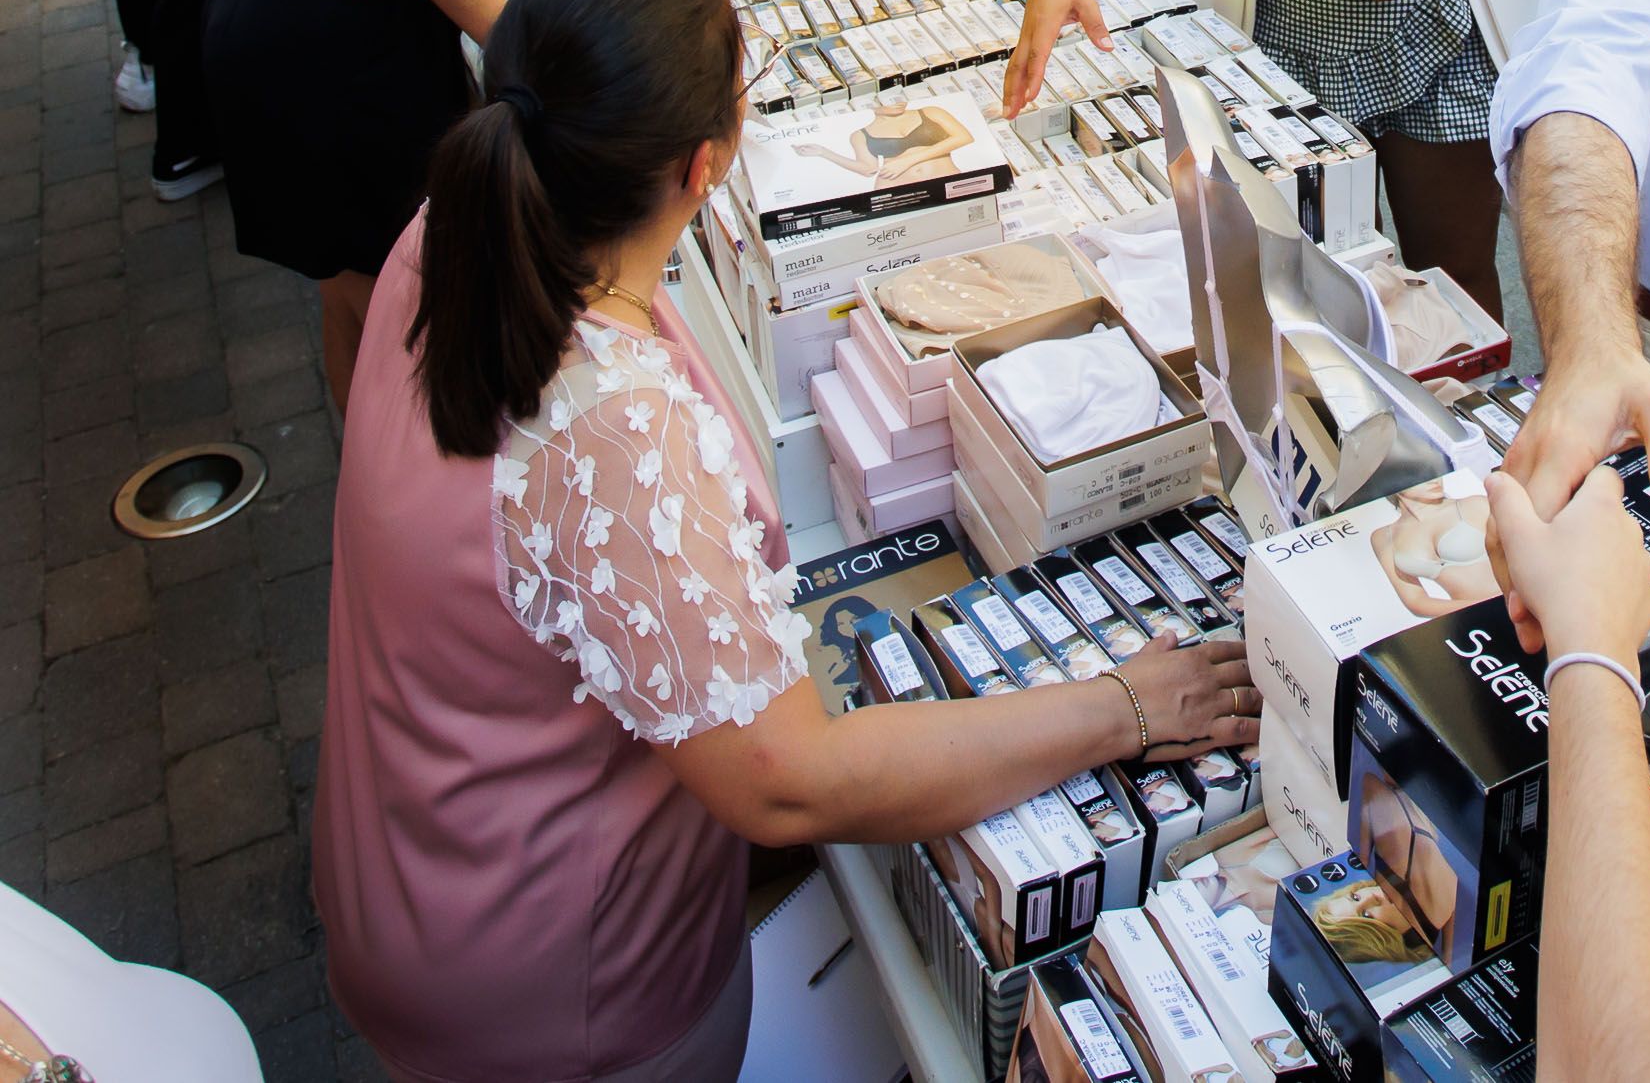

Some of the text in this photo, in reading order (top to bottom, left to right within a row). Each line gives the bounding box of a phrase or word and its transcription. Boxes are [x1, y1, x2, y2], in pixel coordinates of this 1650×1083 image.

[866, 226, 907, 247] Selene
[784, 253, 824, 273] maria
[791, 279, 832, 300] maria
[1266, 522, 1360, 564] Selene
[1264, 636, 1312, 718] Selene
[1445, 629, 1550, 734] Selene
[1513, 670, 1550, 710] creacio
[1358, 672, 1399, 734] Selene
[1081, 799, 1116, 818] Selene
[1283, 785, 1334, 858] Selene
[1498, 958, 1516, 974] ely
[1296, 982, 1353, 1082] Selene
